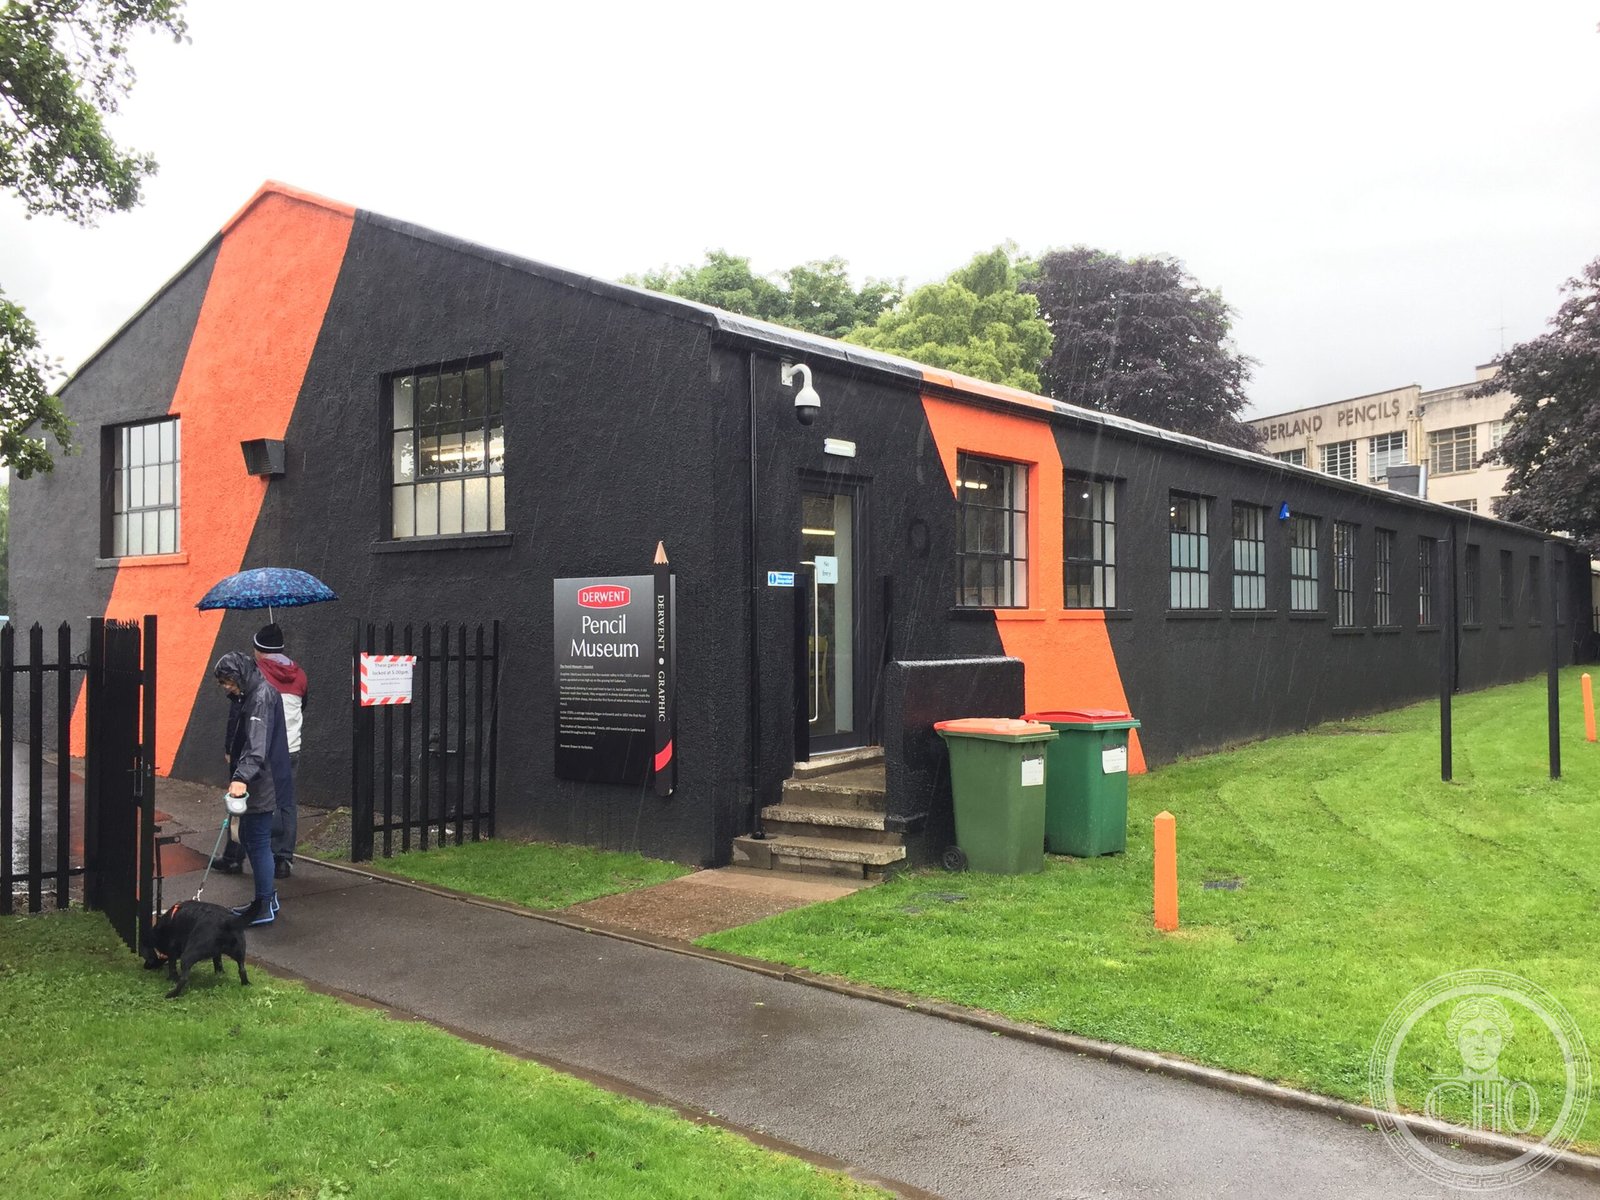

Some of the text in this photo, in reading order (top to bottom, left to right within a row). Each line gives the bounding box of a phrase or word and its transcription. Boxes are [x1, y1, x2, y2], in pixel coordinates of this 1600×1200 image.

[1257, 399, 1400, 442] BERLAND PENCILS
[582, 590, 626, 604] DERWENT
[582, 614, 627, 635] Pencil
[657, 595, 665, 652] DERWENT
[570, 638, 640, 658] Museum
[658, 670, 666, 722] GRAPHIC
